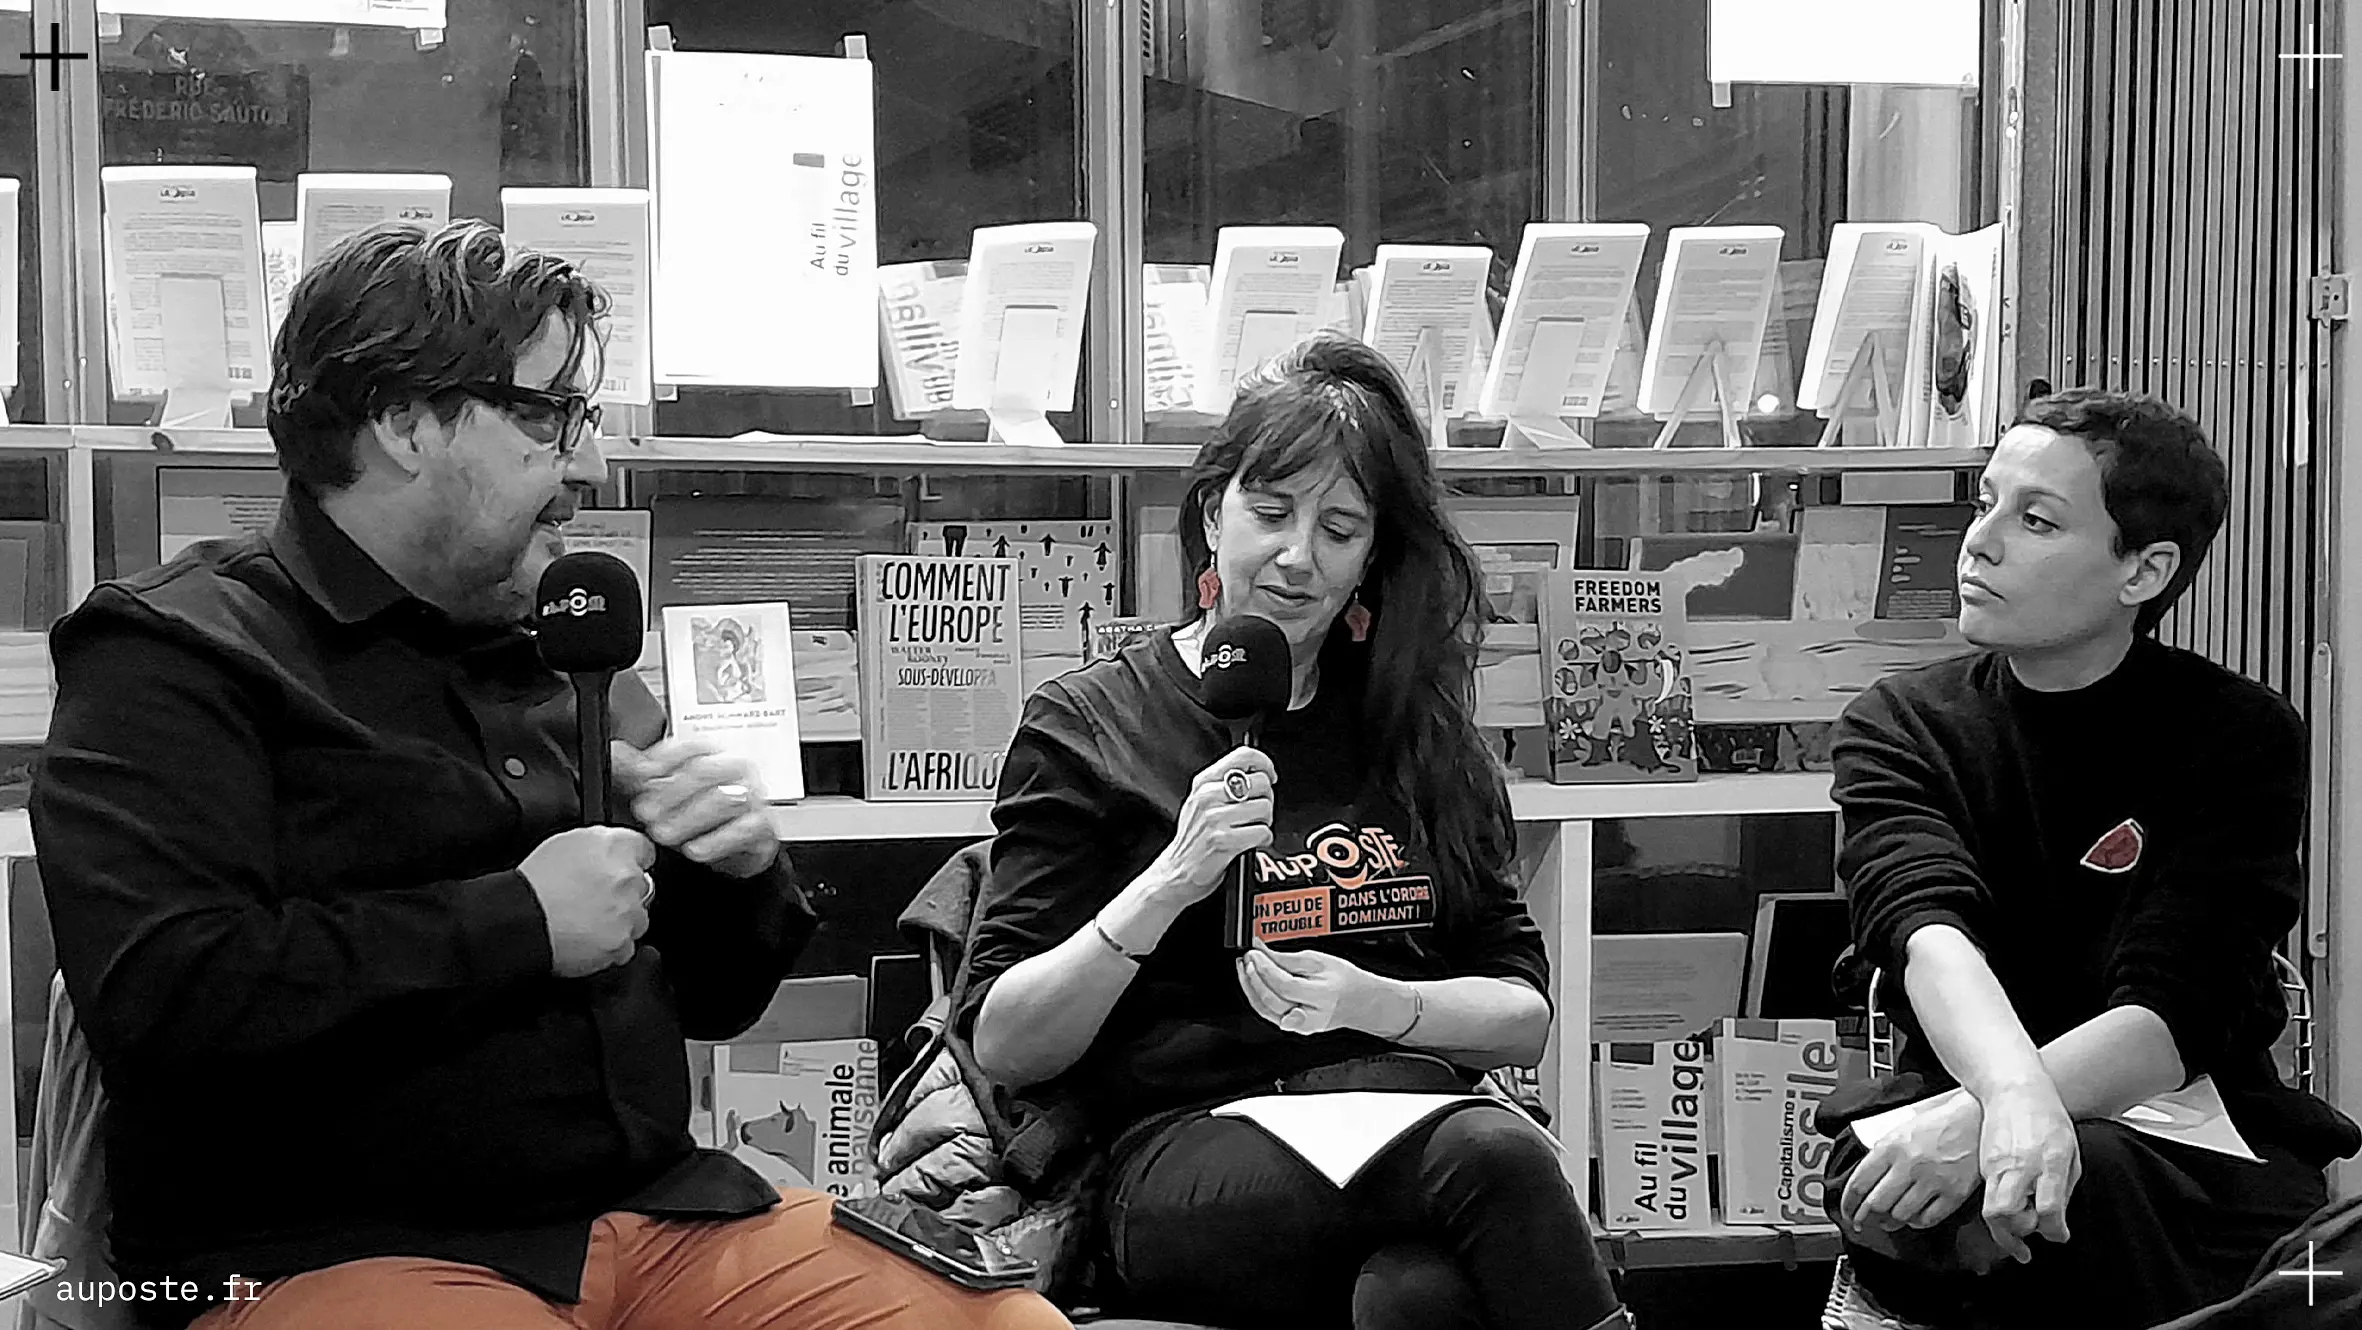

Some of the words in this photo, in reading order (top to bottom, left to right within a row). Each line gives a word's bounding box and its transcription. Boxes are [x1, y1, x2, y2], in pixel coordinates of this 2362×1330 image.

[832, 153, 868, 249] village
[810, 222, 827, 239] fil
[810, 245, 827, 270] Au
[835, 253, 850, 276] du
[882, 561, 1012, 602] COMMENT
[1574, 579, 1660, 597] FREEDOM
[1575, 596, 1662, 613] FARMERS
[889, 604, 1003, 643] L'EUROPE
[888, 752, 999, 790] L'AFRIQU
[1274, 899, 1302, 917] PEU
[1304, 896, 1323, 912] DE
[1338, 889, 1378, 909] DANS
[1261, 914, 1324, 935] TROUBLE
[822, 1063, 854, 1175] animale
[1660, 1042, 1704, 1182] village
[1634, 1142, 1658, 1166] fil
[1634, 1175, 1658, 1213] Au
[1663, 1187, 1687, 1220] du
